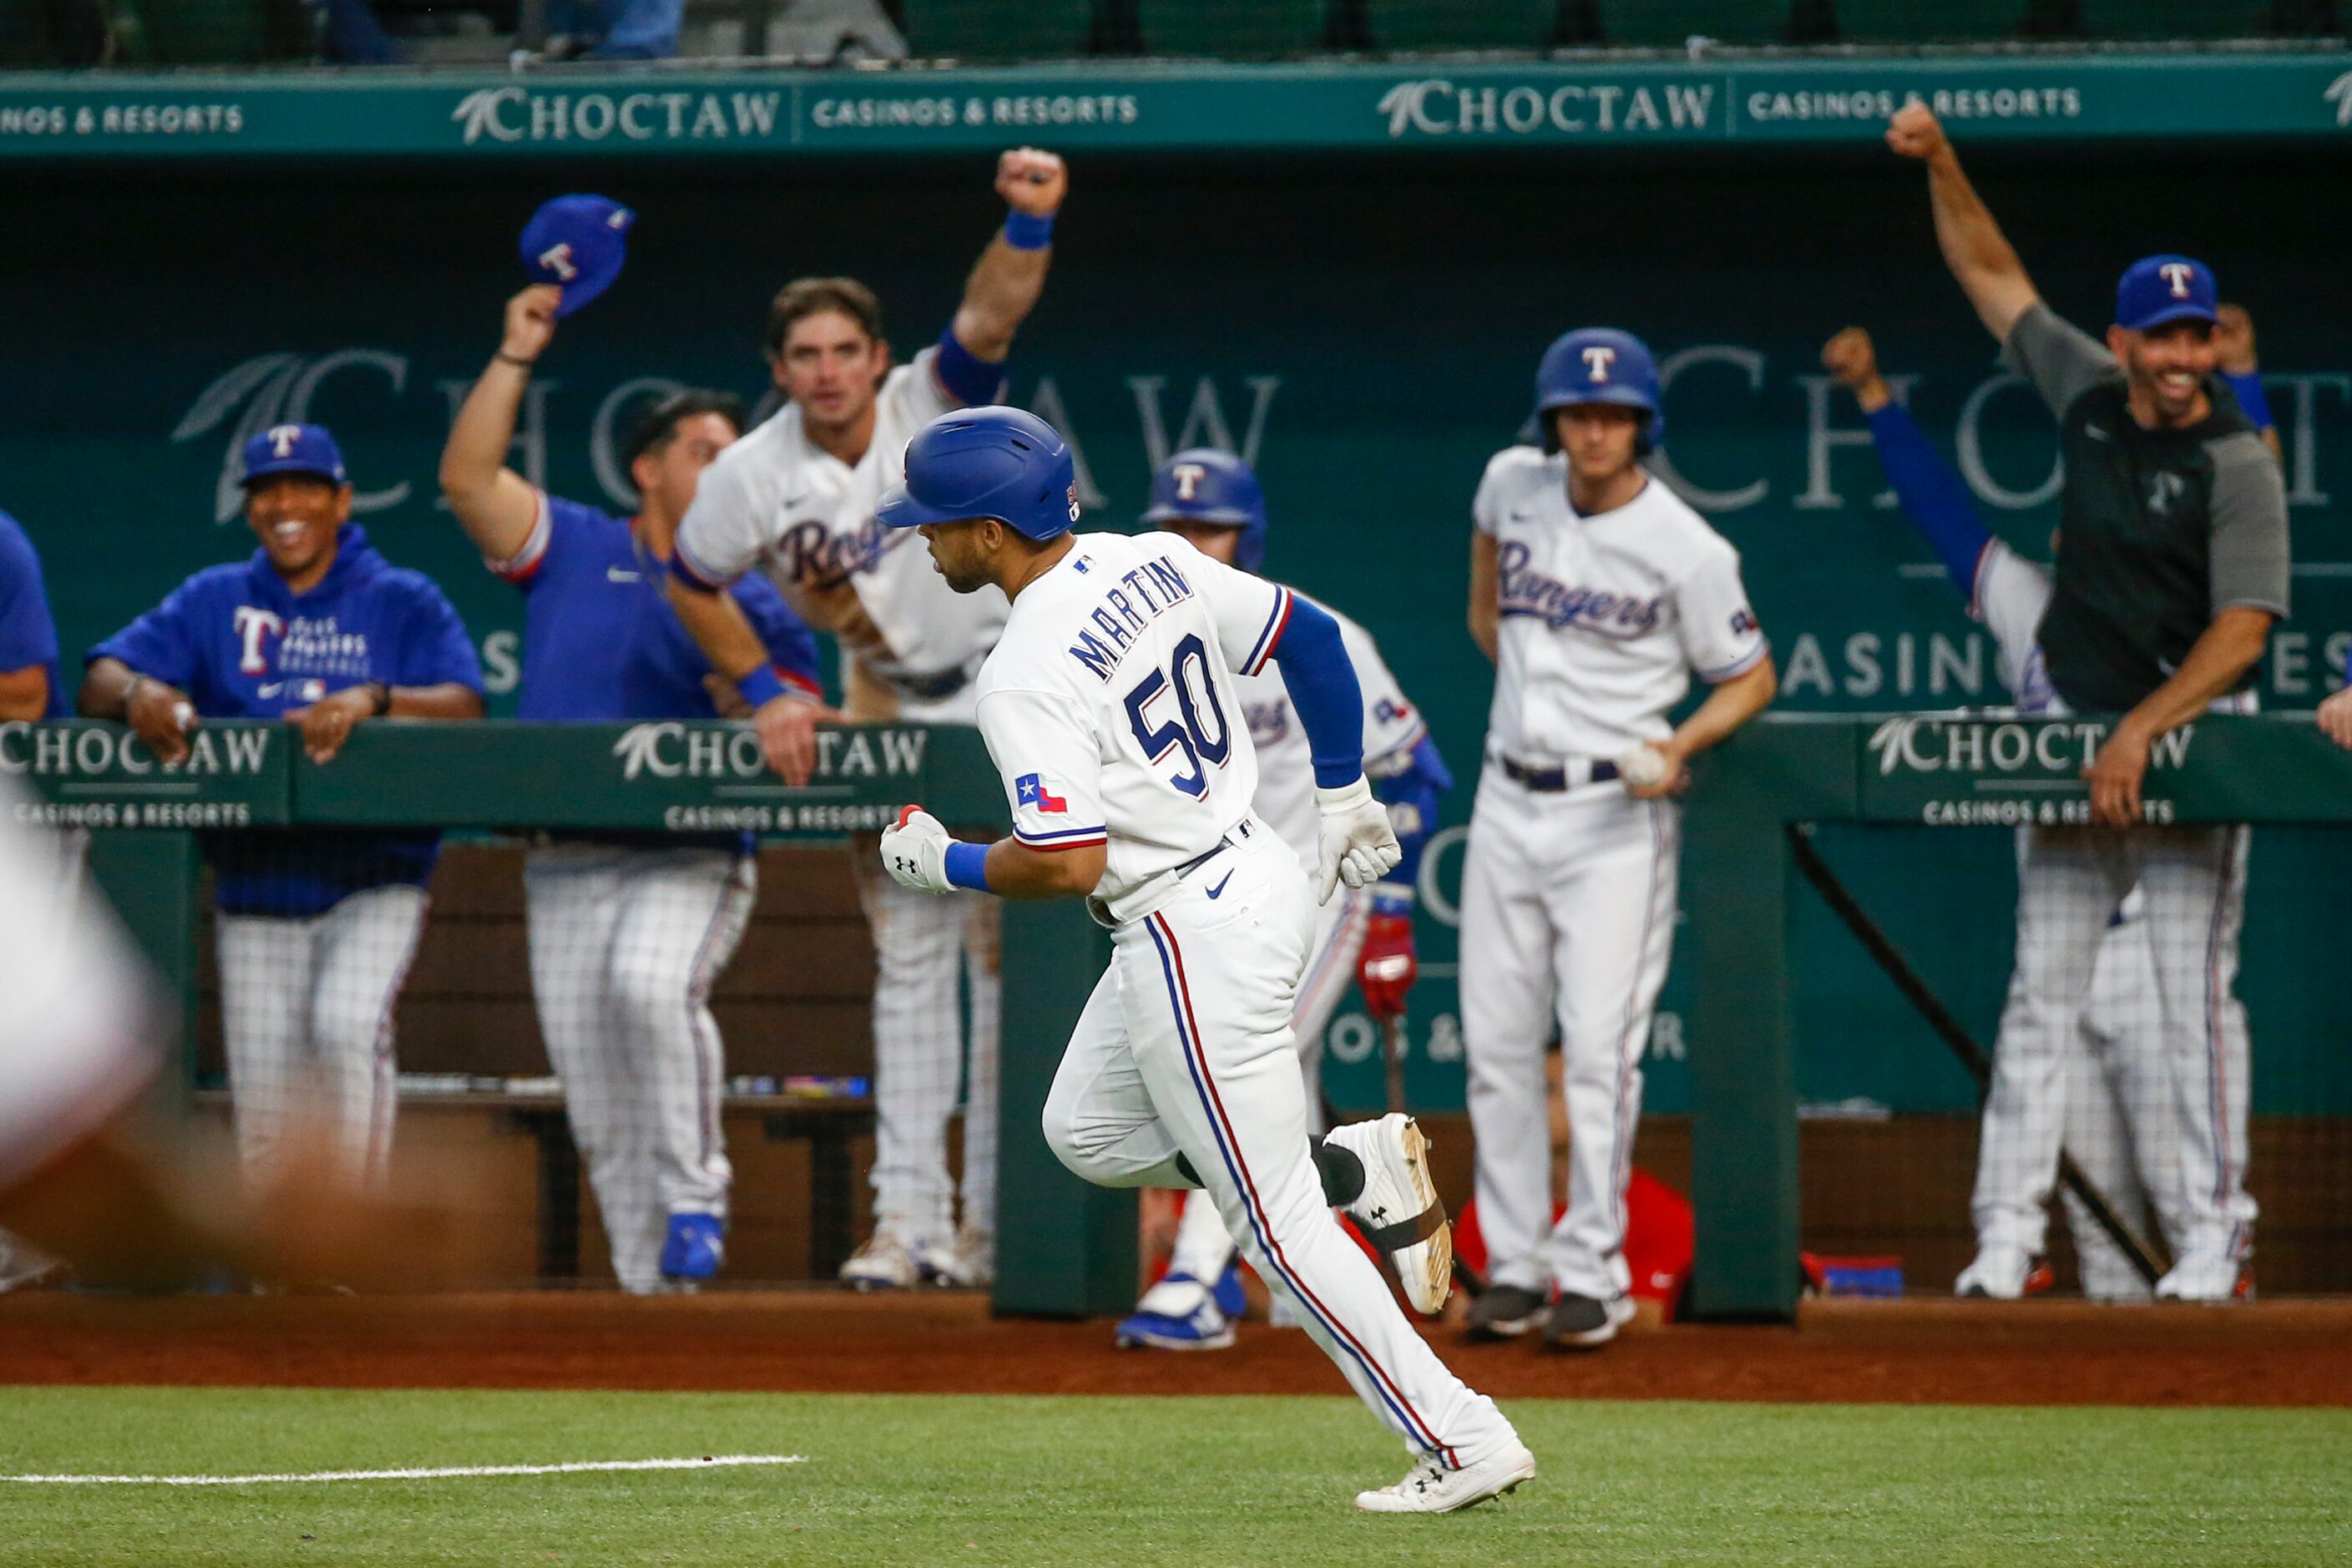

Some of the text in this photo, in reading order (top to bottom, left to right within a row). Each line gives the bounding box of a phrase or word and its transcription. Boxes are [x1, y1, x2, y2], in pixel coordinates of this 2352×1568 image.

[75, 106, 95, 134] &
[103, 105, 243, 134] RESORTS
[468, 87, 781, 143] CHOCTAW
[812, 95, 1138, 128] CASINOS & RESORTS
[1394, 80, 1713, 136] CHOCTAW
[1748, 89, 1894, 121] CASINOS
[1932, 87, 2081, 118] RESORTS
[538, 242, 578, 281] T
[2158, 262, 2194, 299] T
[1581, 346, 1617, 383] T
[268, 424, 302, 458] T
[1172, 464, 1206, 501] T
[1069, 554, 1194, 684] MARTIN
[234, 605, 289, 677] T
[1124, 633, 1232, 802] 50
[0, 721, 268, 775] CHOCAW
[630, 721, 927, 778] CHOTAW
[1889, 718, 2195, 772] CHOCTW
[16, 802, 250, 827] CASINOS & RESORTS
[665, 805, 771, 832] CASINOS
[776, 806, 795, 831] &
[1922, 799, 2174, 826] CASINOS & RETS
